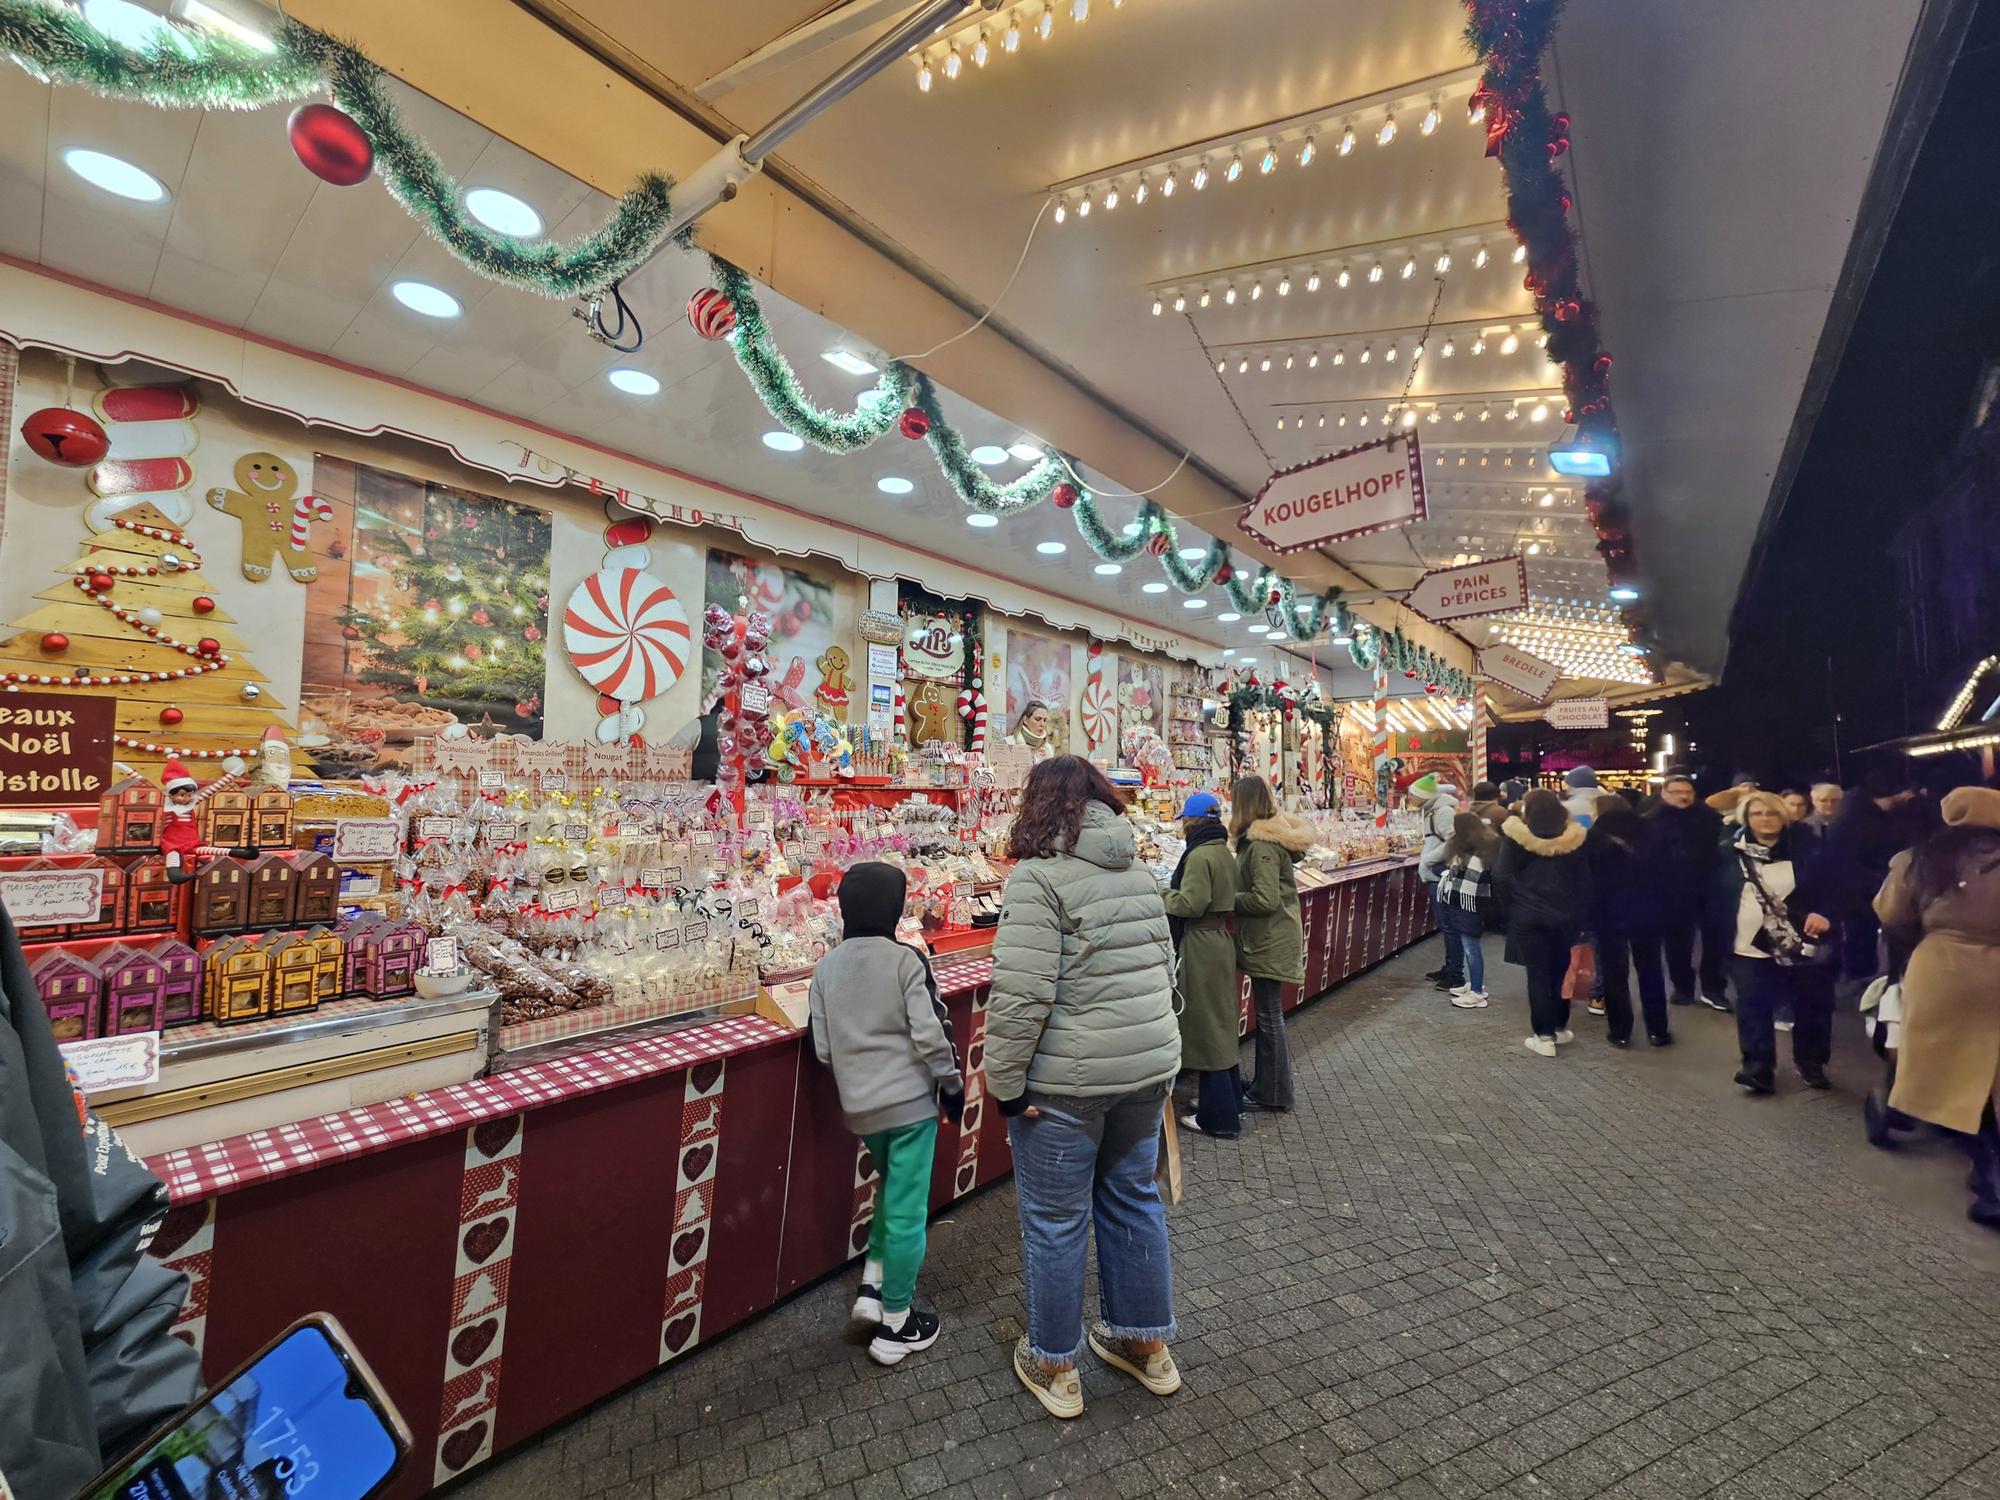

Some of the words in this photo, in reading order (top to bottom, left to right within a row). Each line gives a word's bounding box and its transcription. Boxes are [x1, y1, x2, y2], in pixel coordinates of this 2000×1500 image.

[1264, 469, 1406, 526] KOUGELHOPF
[1454, 574, 1490, 590] PAIN
[1440, 586, 1507, 607] D'ÉPICES
[1502, 654, 1547, 679] BREDELE
[0, 707, 76, 727] eaux
[0, 731, 71, 755] Noël
[594, 752, 623, 762] Nougat
[252, 1406, 320, 1496] 17:53
